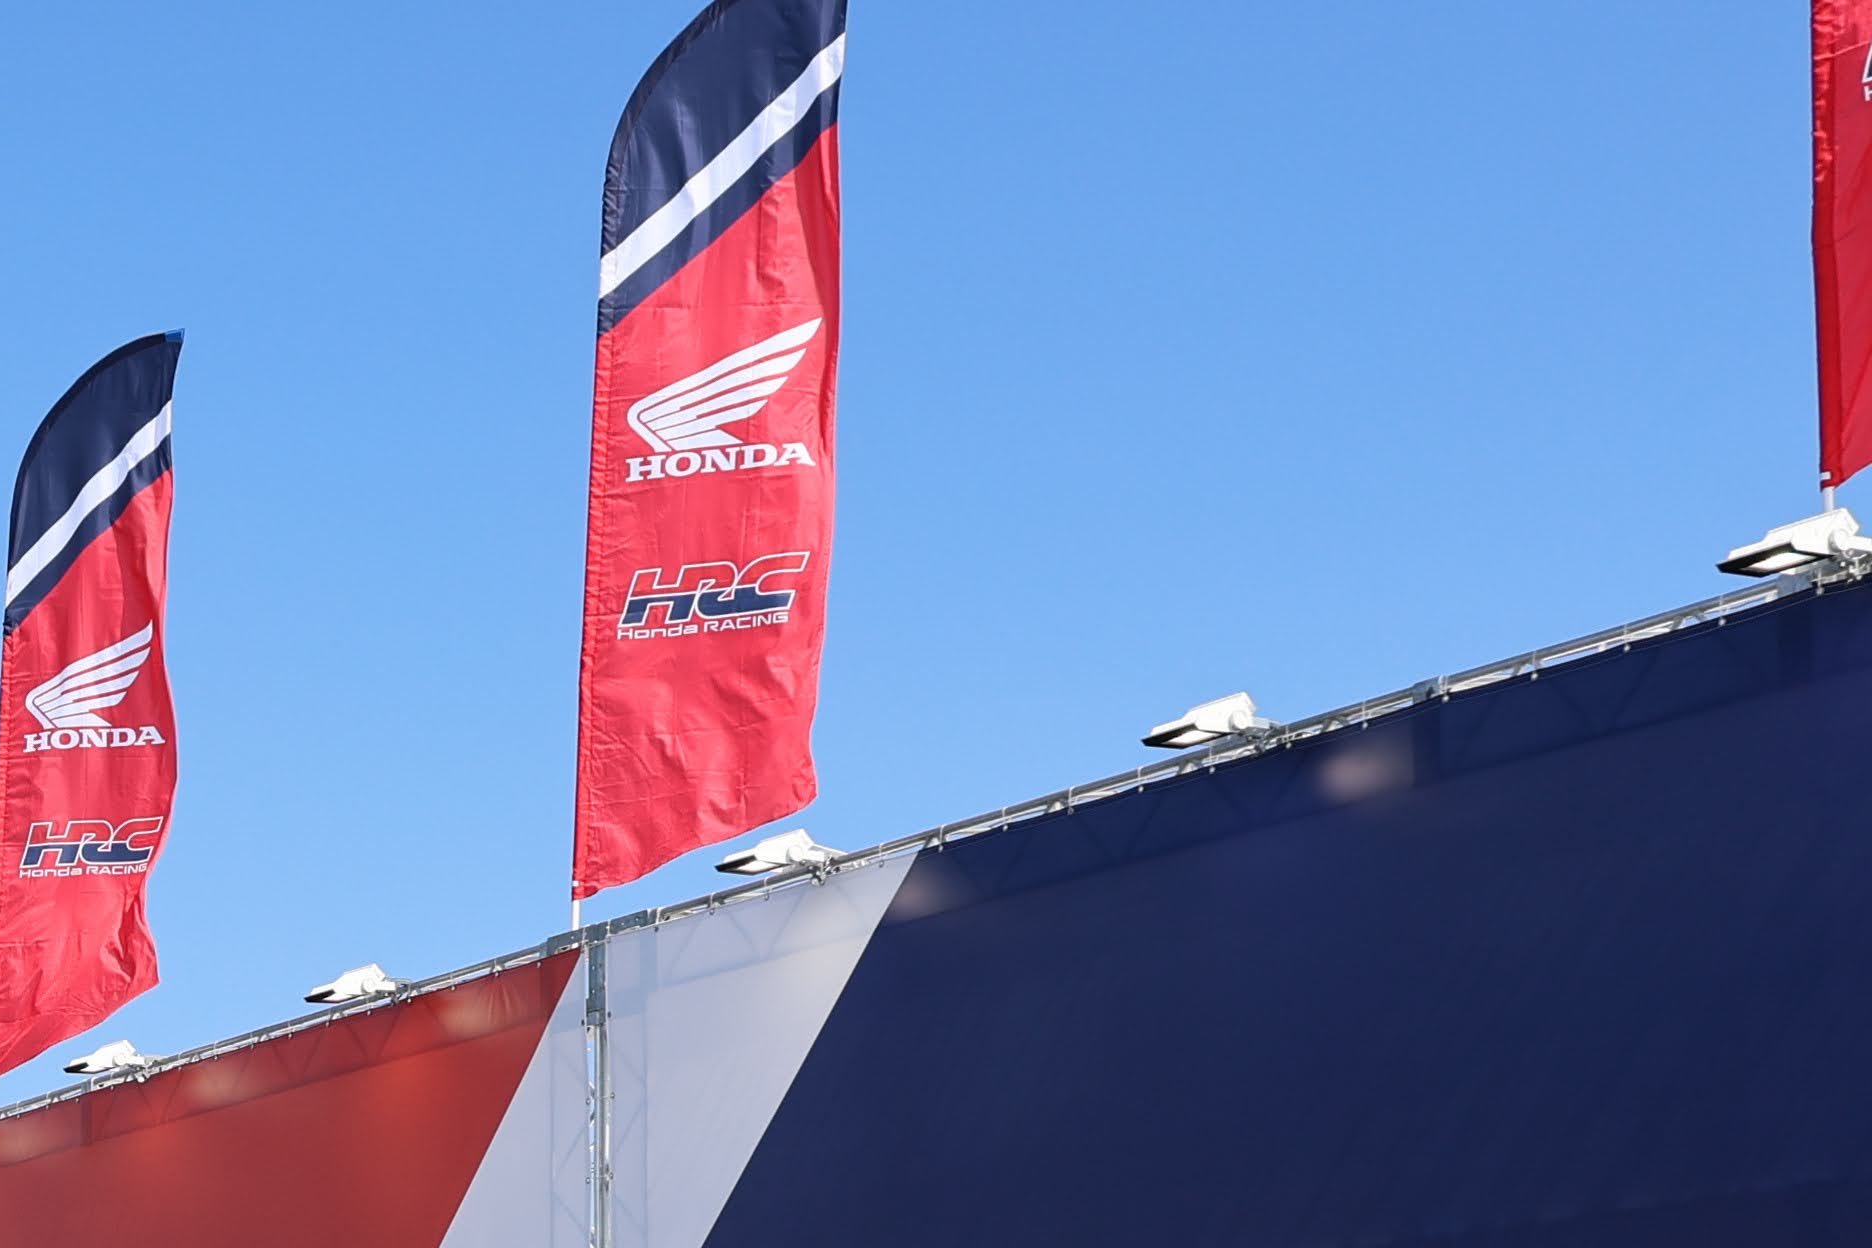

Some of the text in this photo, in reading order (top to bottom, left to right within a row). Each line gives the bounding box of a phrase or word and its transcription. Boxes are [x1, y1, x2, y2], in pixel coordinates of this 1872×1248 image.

[625, 443, 816, 482] HONDA
[617, 551, 810, 627] HRC
[617, 612, 789, 640] Honda RACING
[23, 726, 165, 753] HONDA
[19, 816, 164, 868] HRC
[19, 863, 148, 878] Honda RACING
